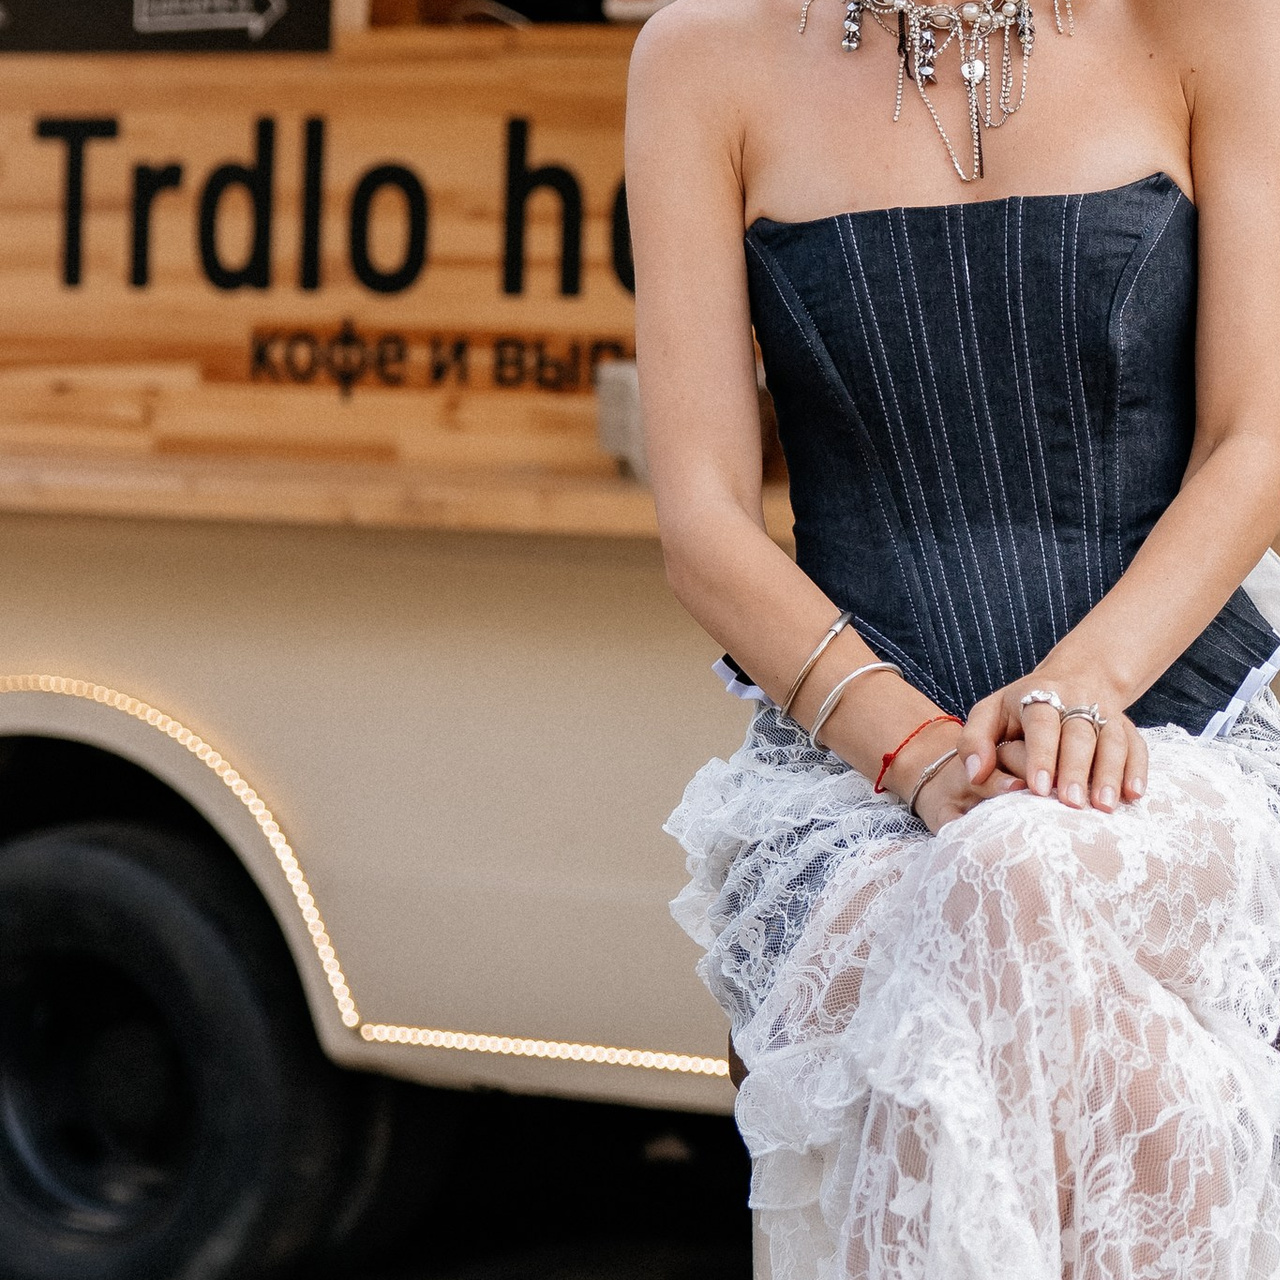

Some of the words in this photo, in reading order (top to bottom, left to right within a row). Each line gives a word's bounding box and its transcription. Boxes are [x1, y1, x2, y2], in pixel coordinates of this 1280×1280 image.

[34, 114, 430, 295] Trdlo
[250, 317, 408, 402] кофе
[429, 334, 468, 387] и
[493, 334, 637, 393] вып
